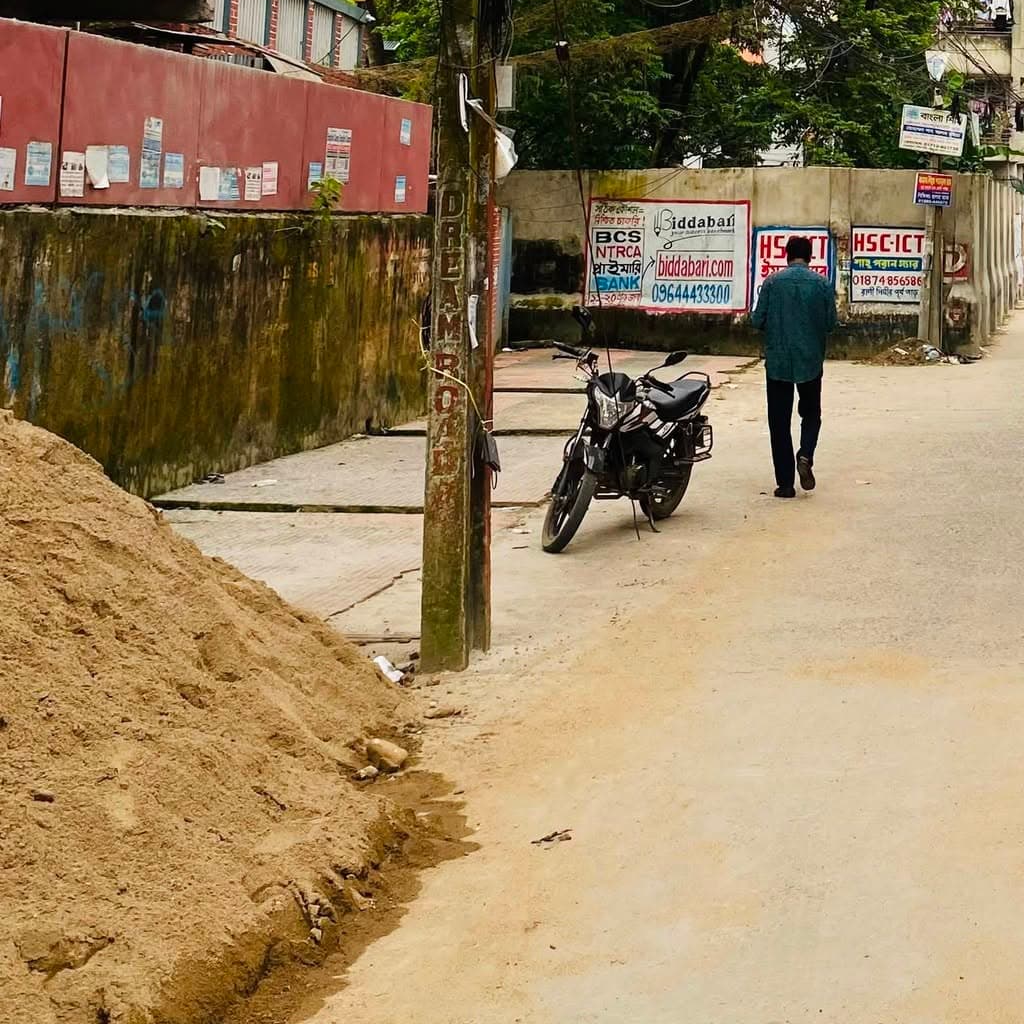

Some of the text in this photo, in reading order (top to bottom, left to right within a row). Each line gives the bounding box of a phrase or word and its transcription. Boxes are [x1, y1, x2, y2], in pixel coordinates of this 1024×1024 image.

[595, 231, 641, 243] BCS
[854, 233, 925, 253] HSC-ICT
[596, 245, 642, 258] NTRCA
[658, 254, 733, 277] biddabari.com
[597, 276, 640, 290] BANK
[652, 284, 730, 304] 09644433300
